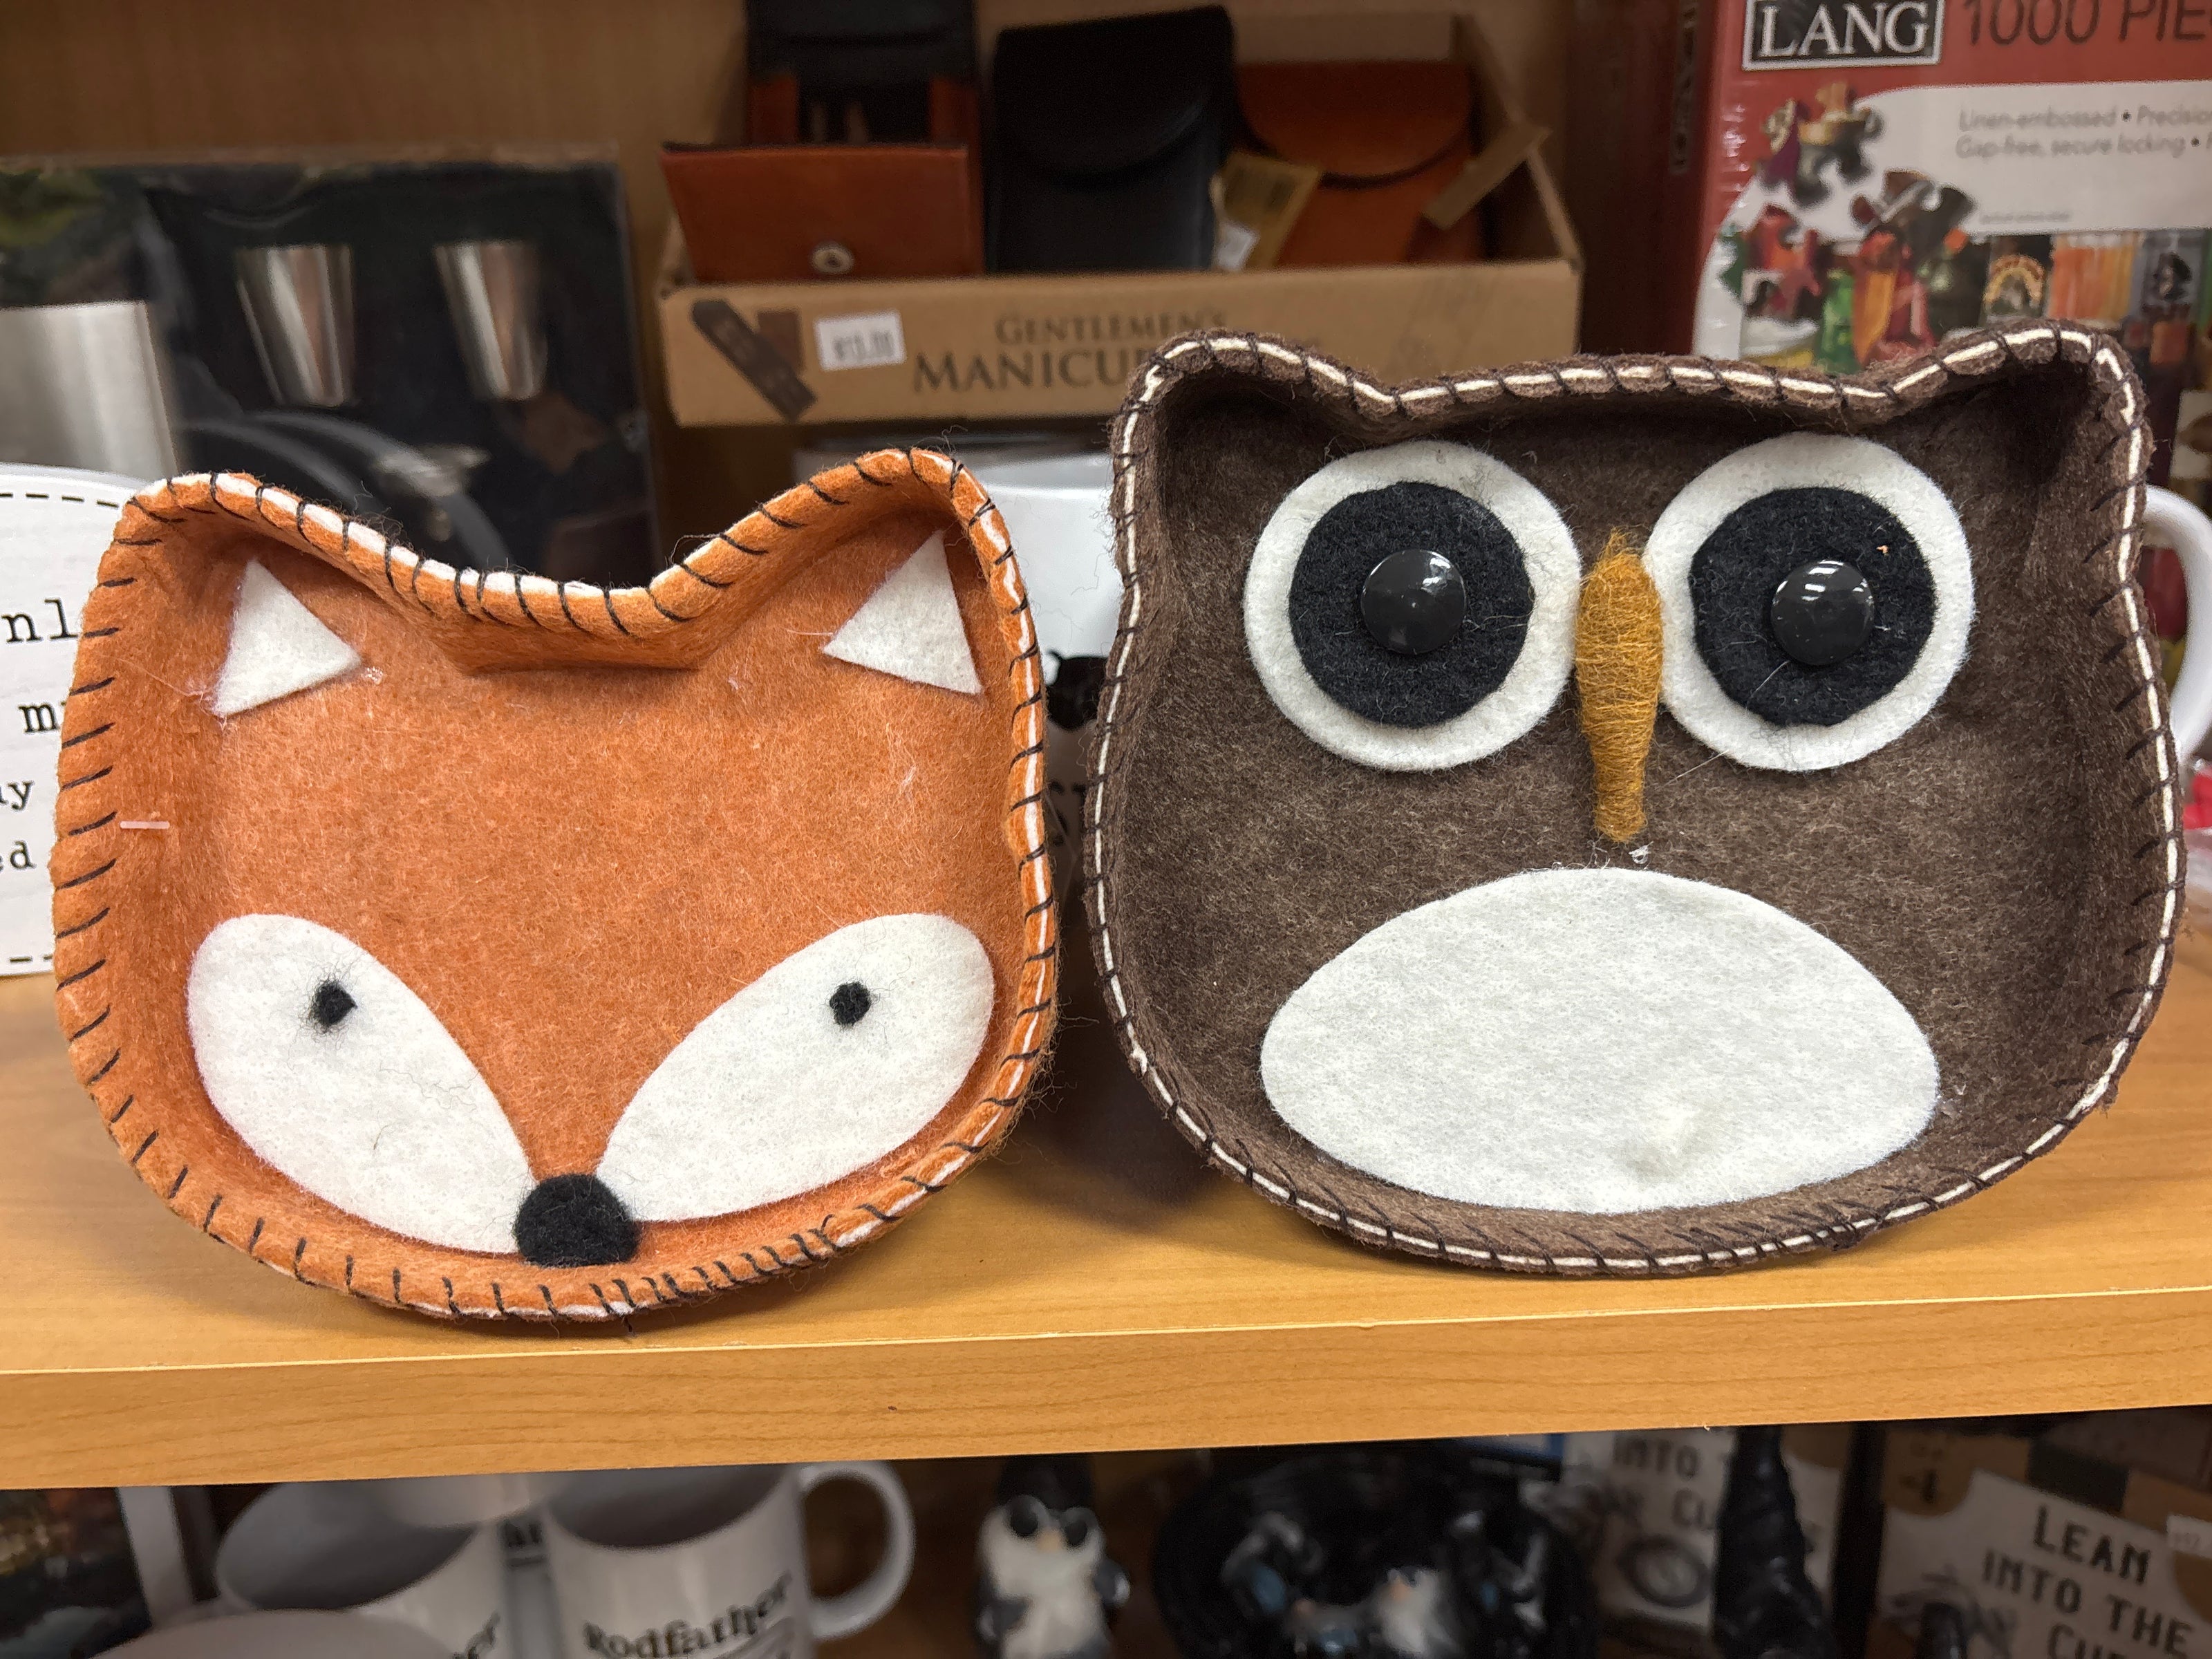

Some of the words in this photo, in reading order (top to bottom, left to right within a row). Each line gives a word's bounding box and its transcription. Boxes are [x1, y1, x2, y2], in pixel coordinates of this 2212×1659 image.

[1757, 2, 1929, 57] LANG
[1965, 0, 2101, 45] 1000
[2119, 0, 2212, 41] PIE
[2032, 1503, 2151, 1586] LEAN
[1981, 1548, 2082, 1615] INTO
[2106, 1593, 2194, 1659] THE
